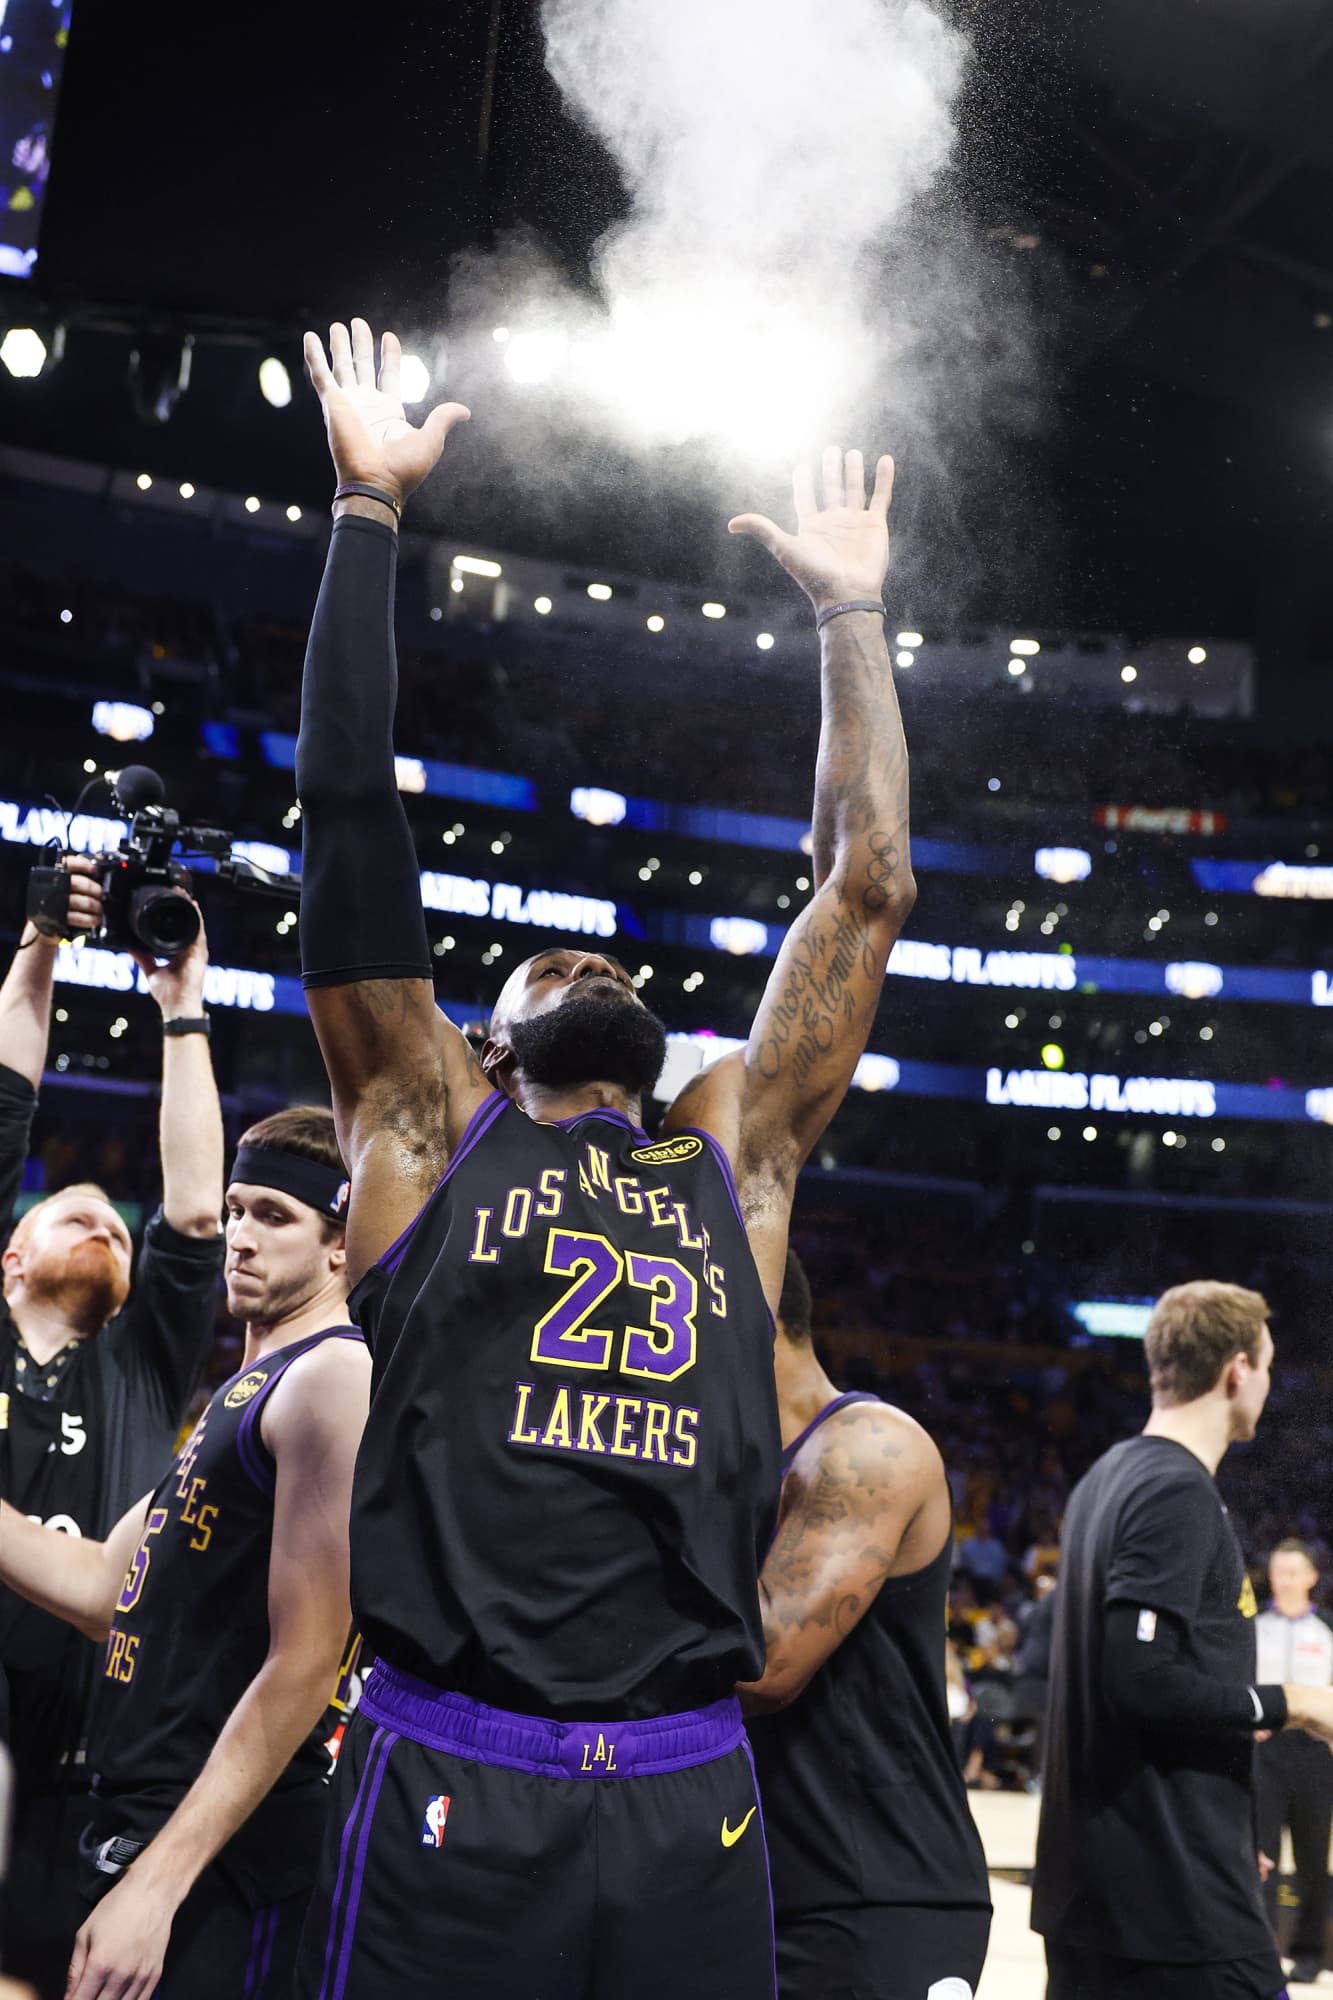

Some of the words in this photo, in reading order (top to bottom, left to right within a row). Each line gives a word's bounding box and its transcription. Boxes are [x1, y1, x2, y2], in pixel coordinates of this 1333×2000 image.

[637, 1141, 697, 1160] bibigo
[468, 1168, 567, 1264] LOS
[530, 1227, 698, 1383] 23
[508, 1381, 700, 1468] LAKERS
[581, 1733, 617, 1771] LAL
